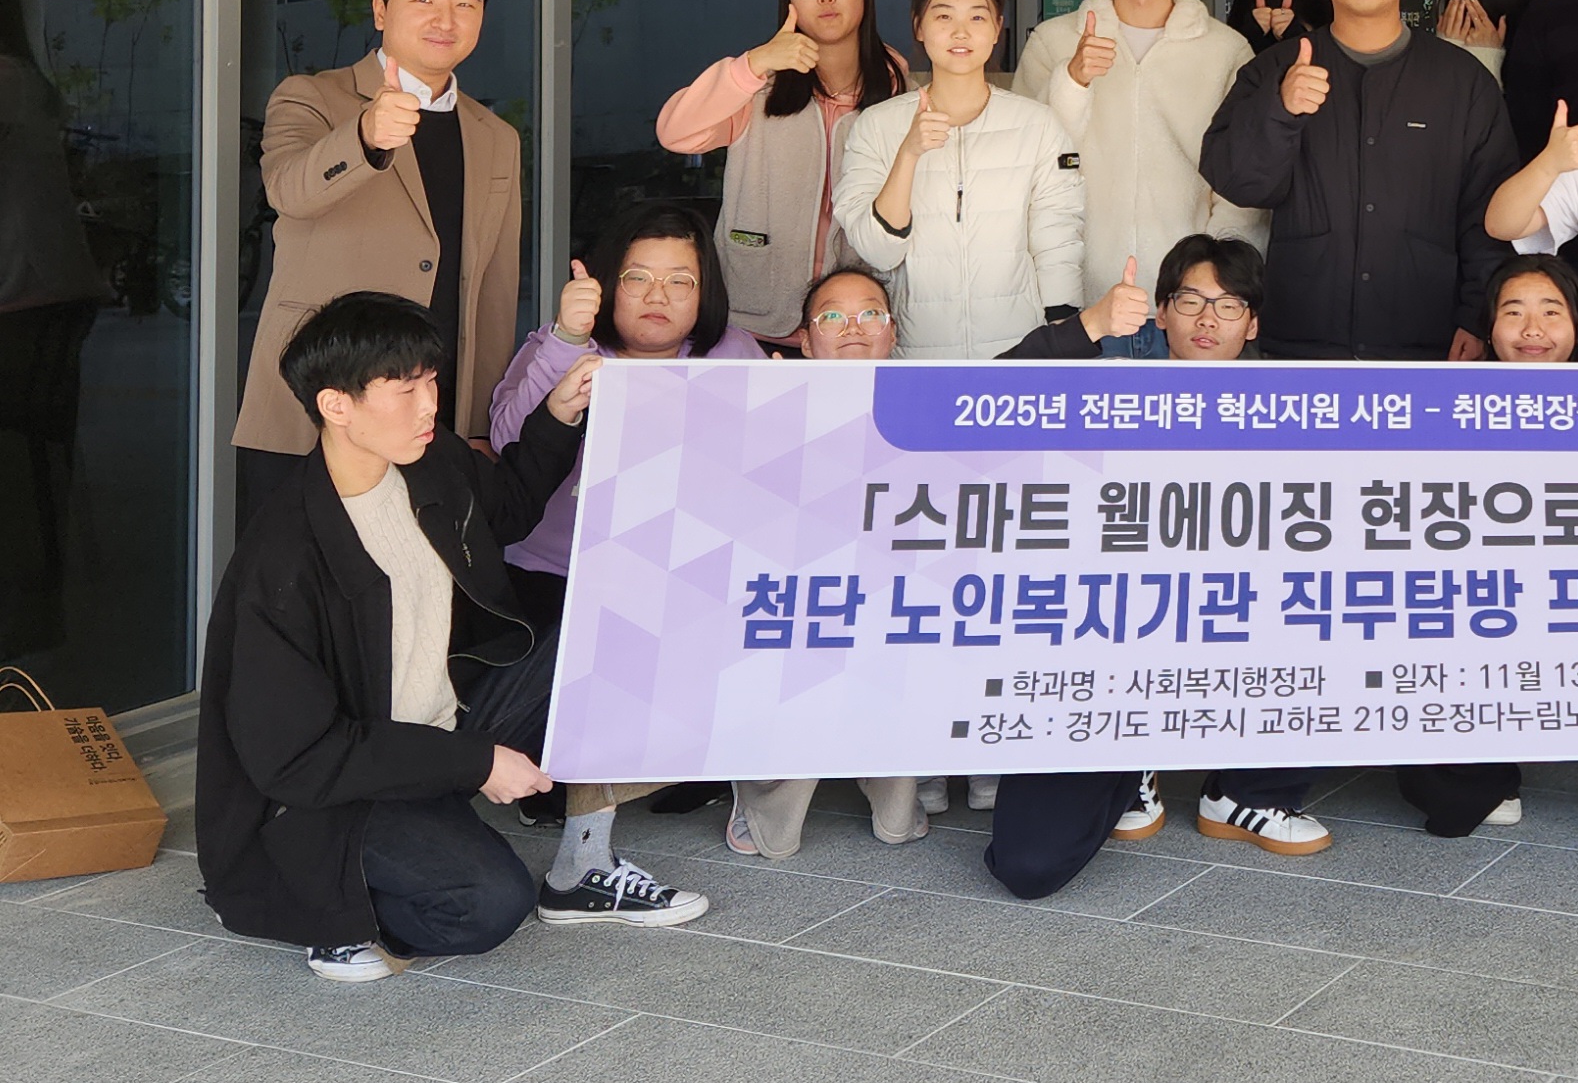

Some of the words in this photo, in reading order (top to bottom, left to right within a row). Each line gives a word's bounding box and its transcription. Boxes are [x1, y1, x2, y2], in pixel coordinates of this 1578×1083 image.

[954, 393, 1067, 429] 2025년
[1079, 393, 1207, 430] 전문대학
[1216, 393, 1340, 430] 혁신지원
[1350, 393, 1412, 430] 사업
[862, 482, 1070, 553] 「스마트
[1097, 481, 1333, 553] 웰에이징
[741, 573, 866, 650] 첨단
[884, 571, 1258, 647] 노인복지기관
[1280, 568, 1524, 642] 직무탐방
[1013, 669, 1095, 703] 학과명
[1125, 665, 1326, 700] 사회복지행정과
[1392, 662, 1448, 694] 일자
[1479, 661, 1542, 692] 11월
[64, 717, 90, 744] 기술을
[80, 745, 108, 773] 더하다.
[86, 715, 111, 742] 마음을
[978, 712, 1034, 745] 장소
[1066, 710, 1150, 743] 경기도
[1161, 707, 1246, 740] 파주시
[1256, 705, 1343, 737] 교하로
[1353, 705, 1409, 732] 219
